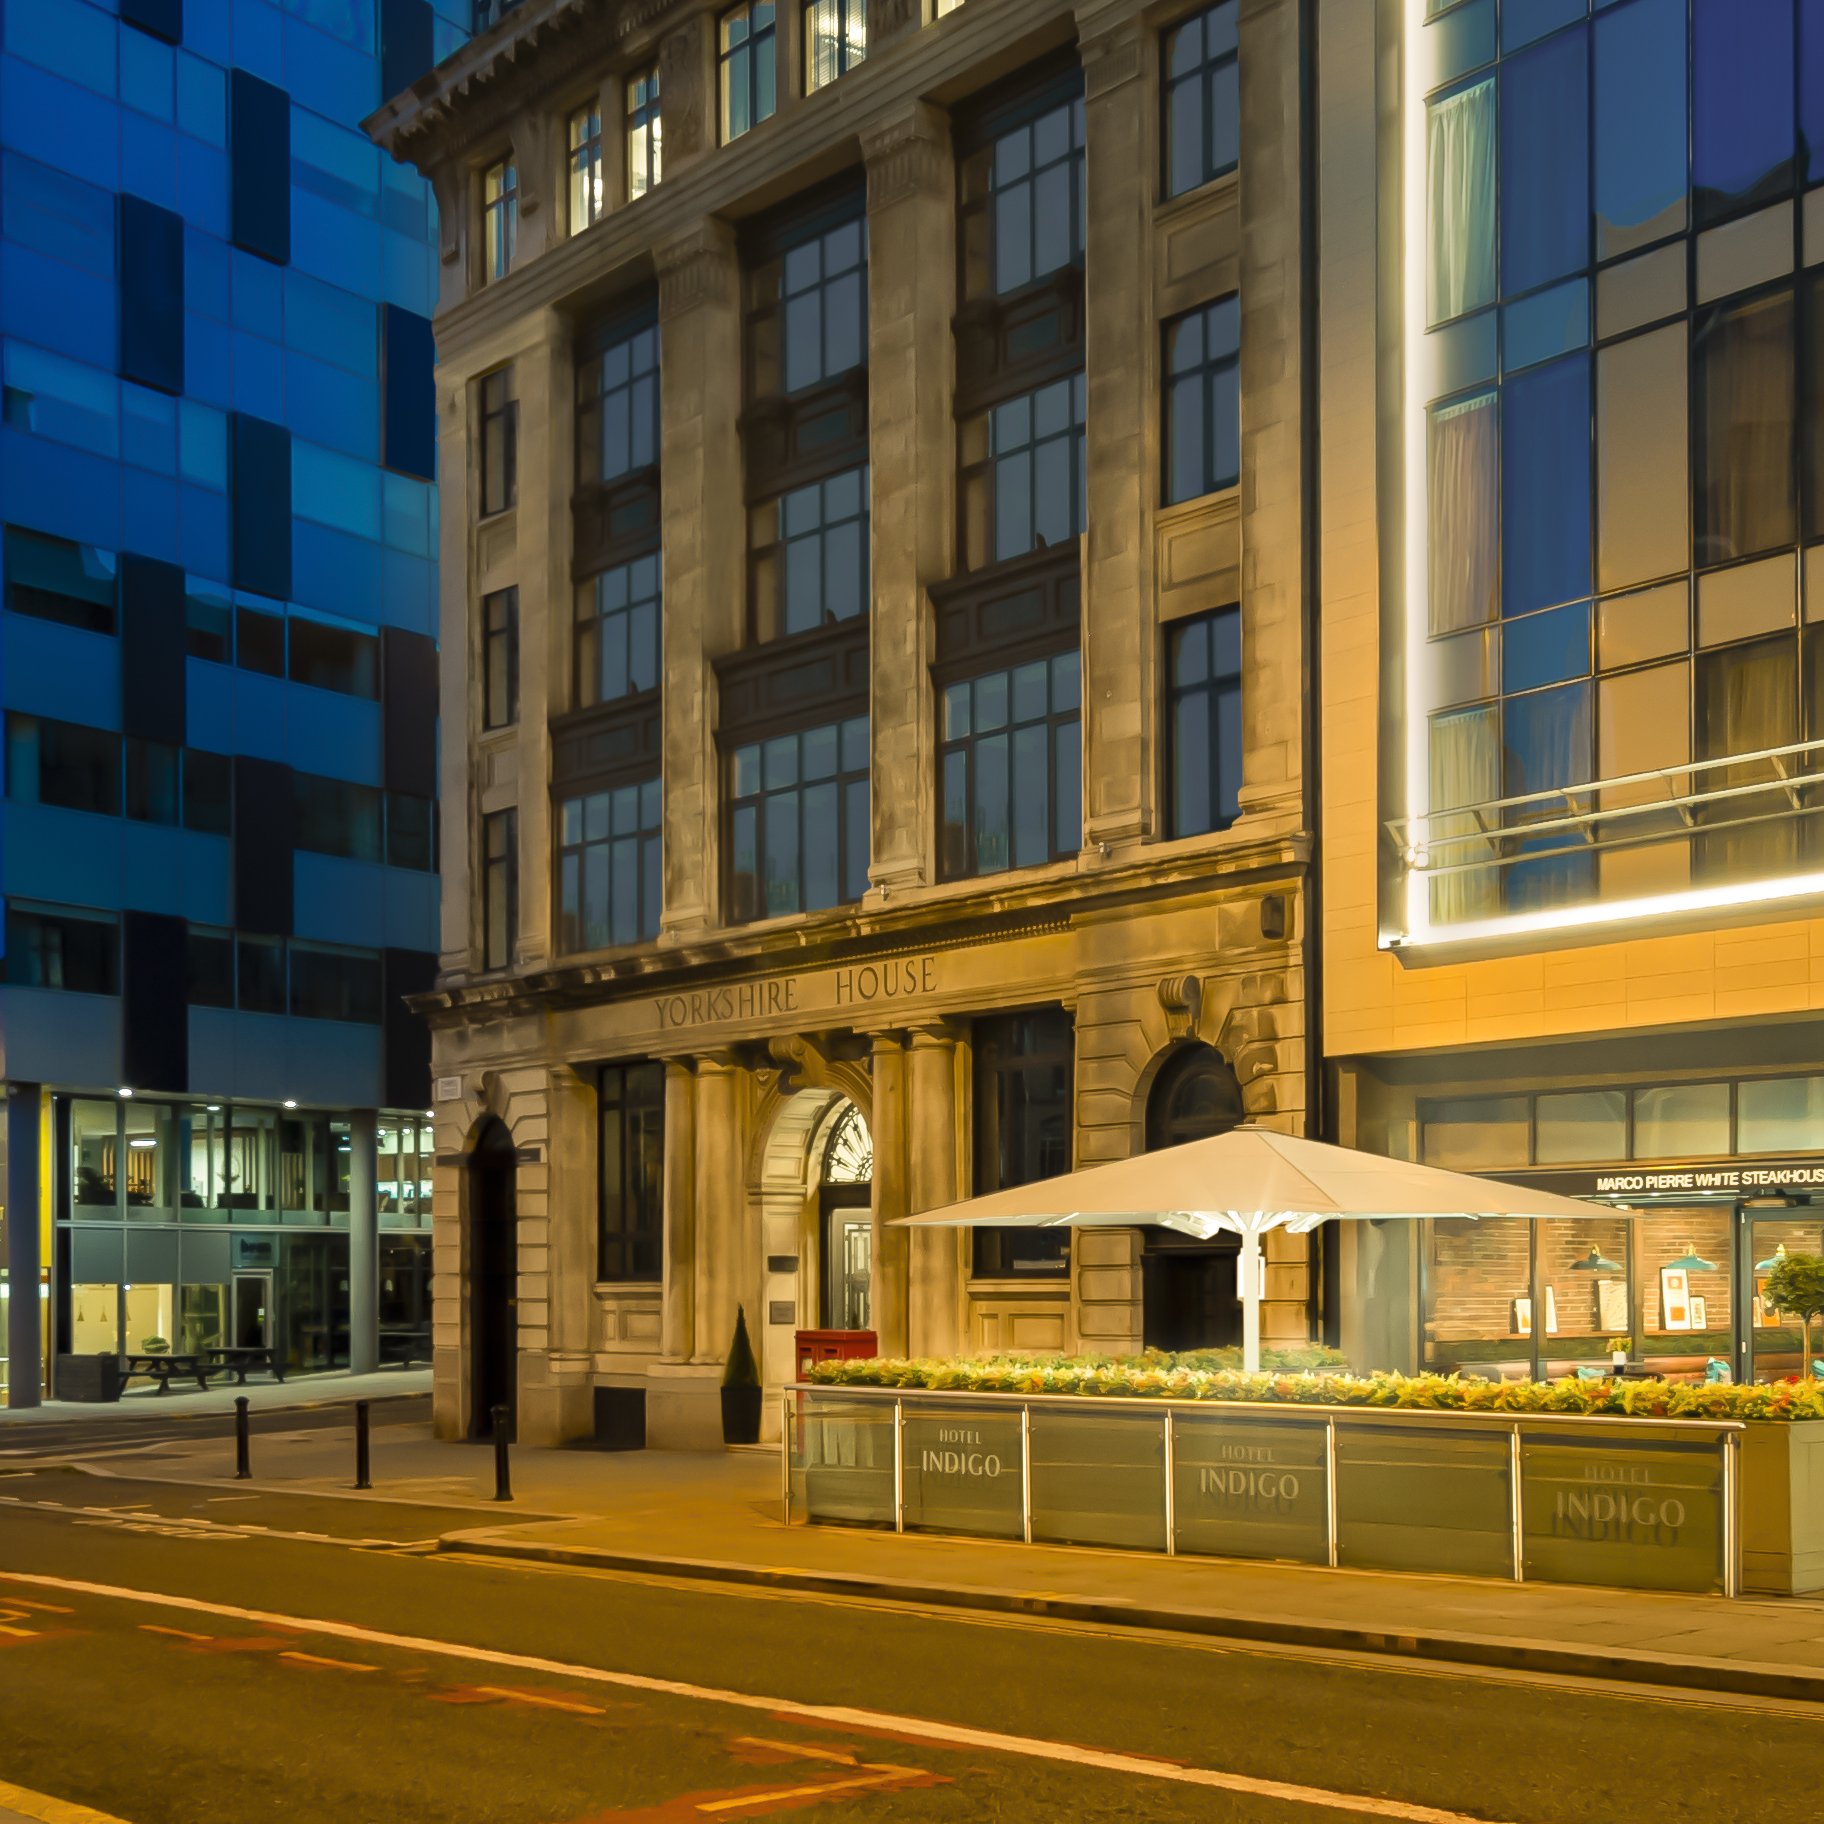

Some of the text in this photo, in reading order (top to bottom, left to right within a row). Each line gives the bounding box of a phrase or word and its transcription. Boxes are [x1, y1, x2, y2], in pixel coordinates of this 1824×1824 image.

[654, 956, 938, 1029] YORKSHIRE HOUSE
[1596, 1176, 1644, 1191] MARCO
[1645, 1174, 1694, 1189] PIERRE
[1694, 1172, 1740, 1187] WHITE
[939, 1428, 982, 1445] HOTEL
[922, 1449, 1001, 1477] INDIGO
[1221, 1444, 1276, 1463] HOTEL
[1199, 1467, 1300, 1500] INDIGO
[1584, 1463, 1650, 1484] HOTEL
[1556, 1491, 1686, 1528] INDIGO
